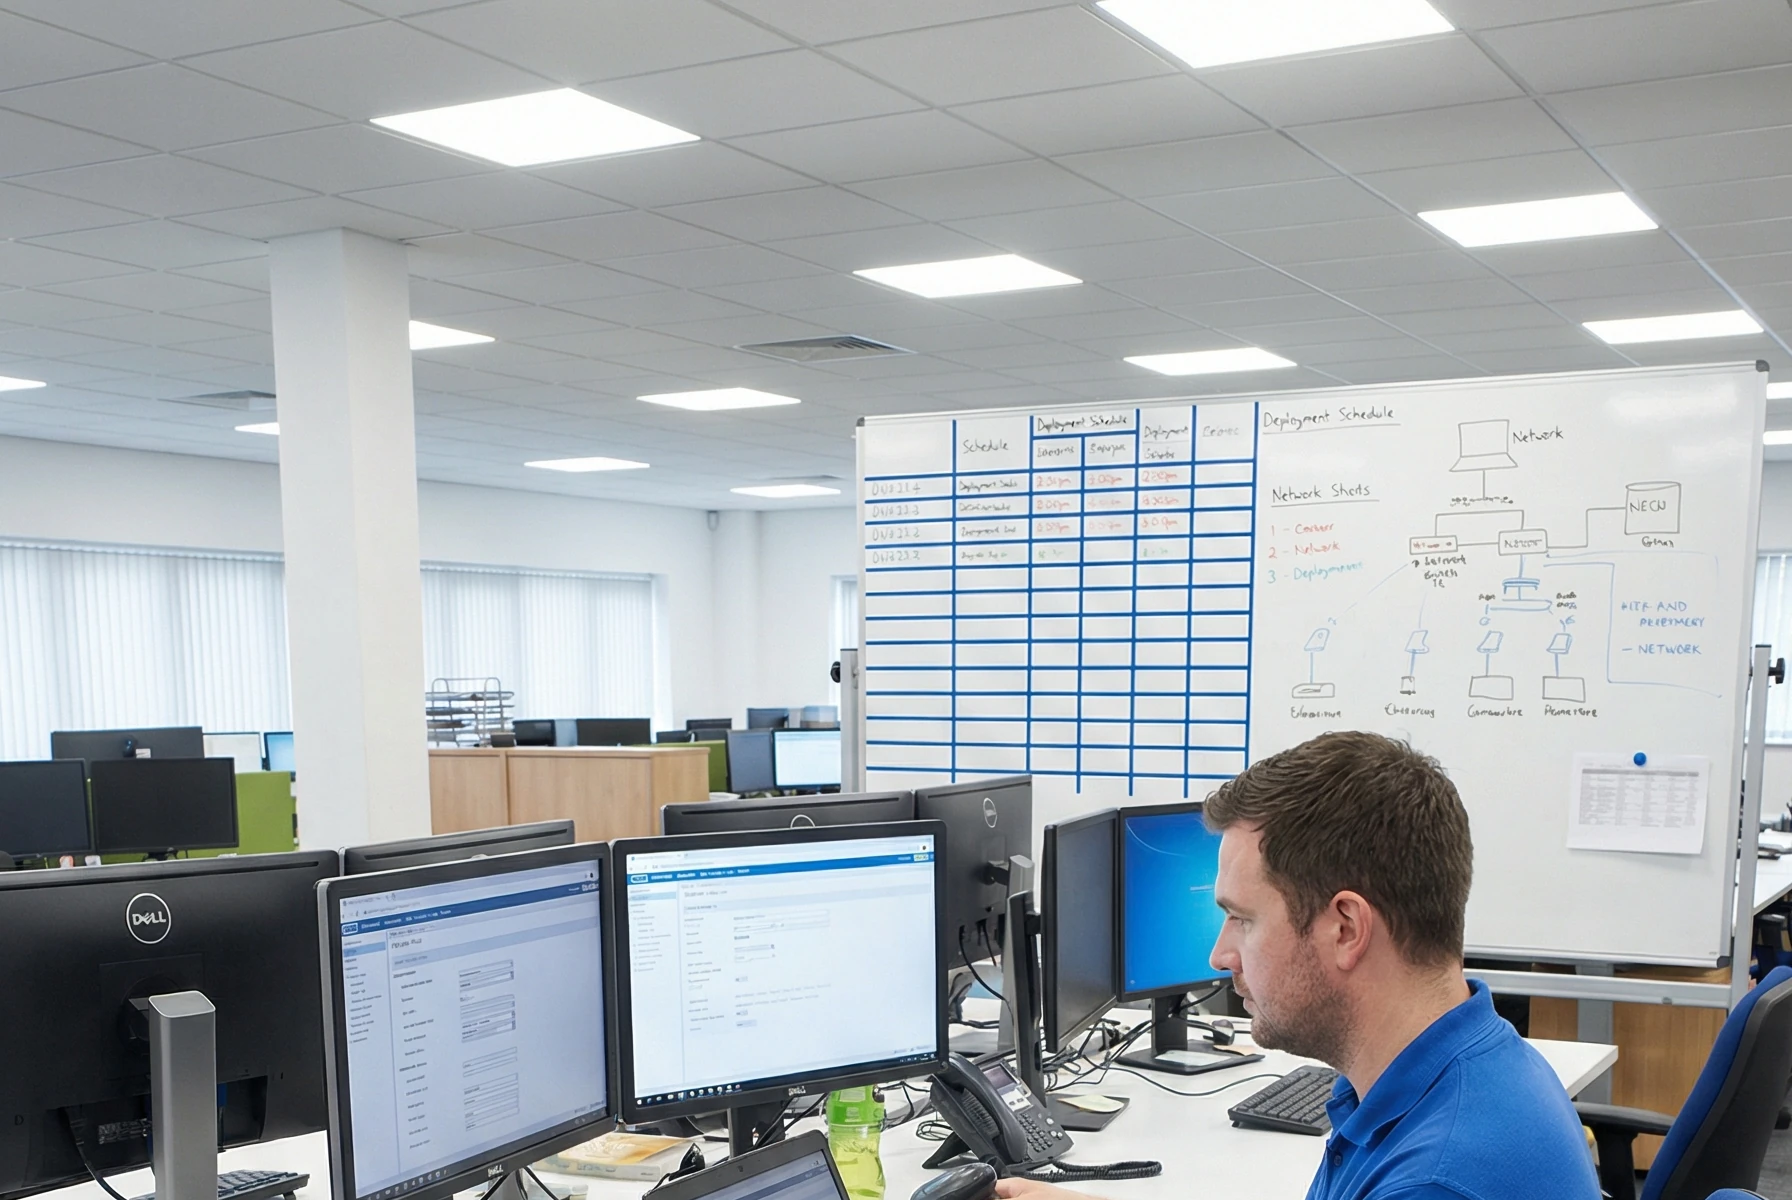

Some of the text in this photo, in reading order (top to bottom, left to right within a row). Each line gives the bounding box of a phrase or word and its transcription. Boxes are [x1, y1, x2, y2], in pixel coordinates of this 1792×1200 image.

[1338, 405, 1394, 422] Schedule
[962, 438, 1009, 454] Schedule
[1656, 600, 1688, 612] AND
[131, 910, 167, 926] DELL
